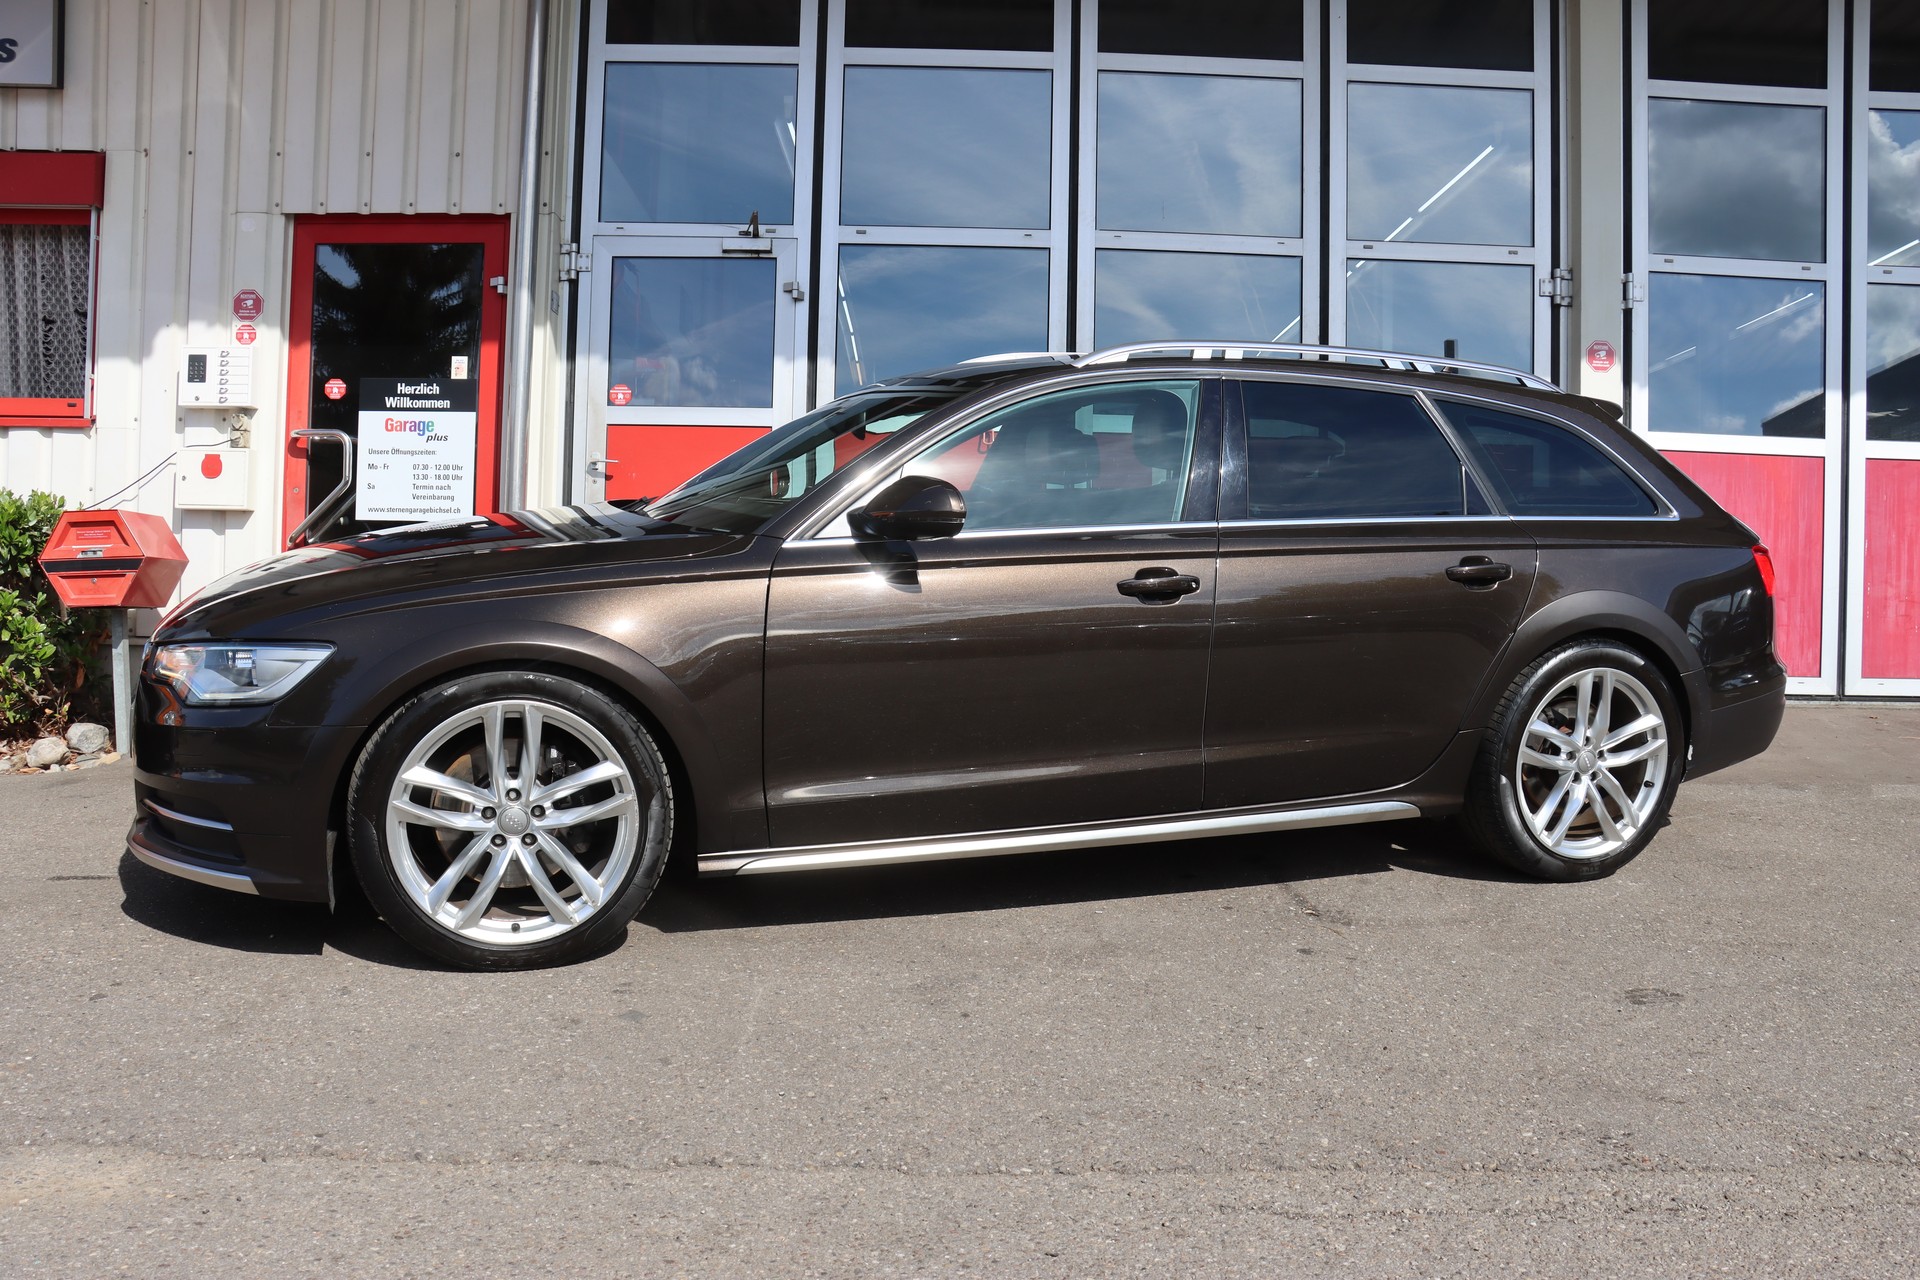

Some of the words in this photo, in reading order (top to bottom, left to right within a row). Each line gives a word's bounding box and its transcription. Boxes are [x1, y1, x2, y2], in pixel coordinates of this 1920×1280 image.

[397, 383, 439, 394] Herzlich
[385, 397, 450, 408] Willkommen
[385, 418, 434, 436] Garage
[426, 433, 449, 443] plus
[391, 447, 437, 457] Öffnungszeiten:
[367, 482, 376, 490] Sa
[412, 483, 434, 491] Termin
[411, 493, 455, 502] Vereinbarung
[367, 507, 461, 515] www.sternengaragebichsel.ch
